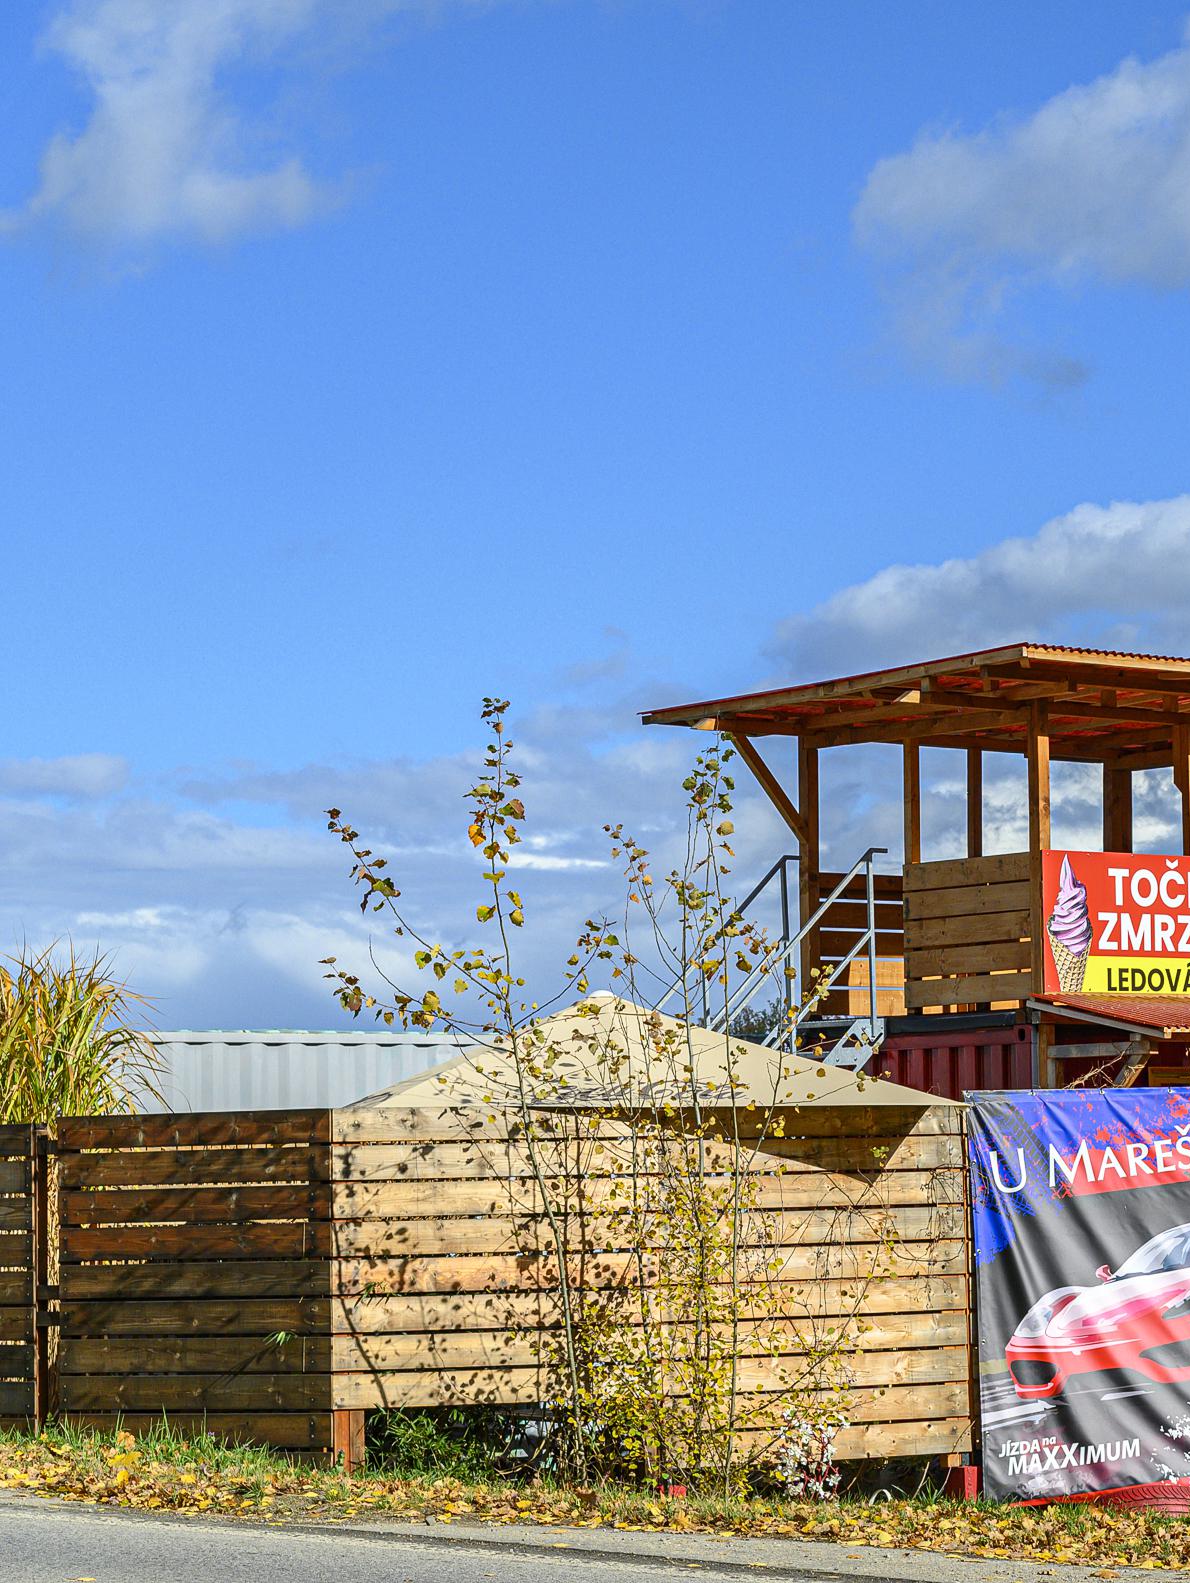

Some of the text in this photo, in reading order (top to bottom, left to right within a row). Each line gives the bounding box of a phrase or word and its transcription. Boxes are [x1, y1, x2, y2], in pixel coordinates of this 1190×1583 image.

[989, 1147, 1027, 1194] U
[999, 1436, 1056, 1458] JÍZDA na
[1008, 1438, 1141, 1476] MAXXIMUM
